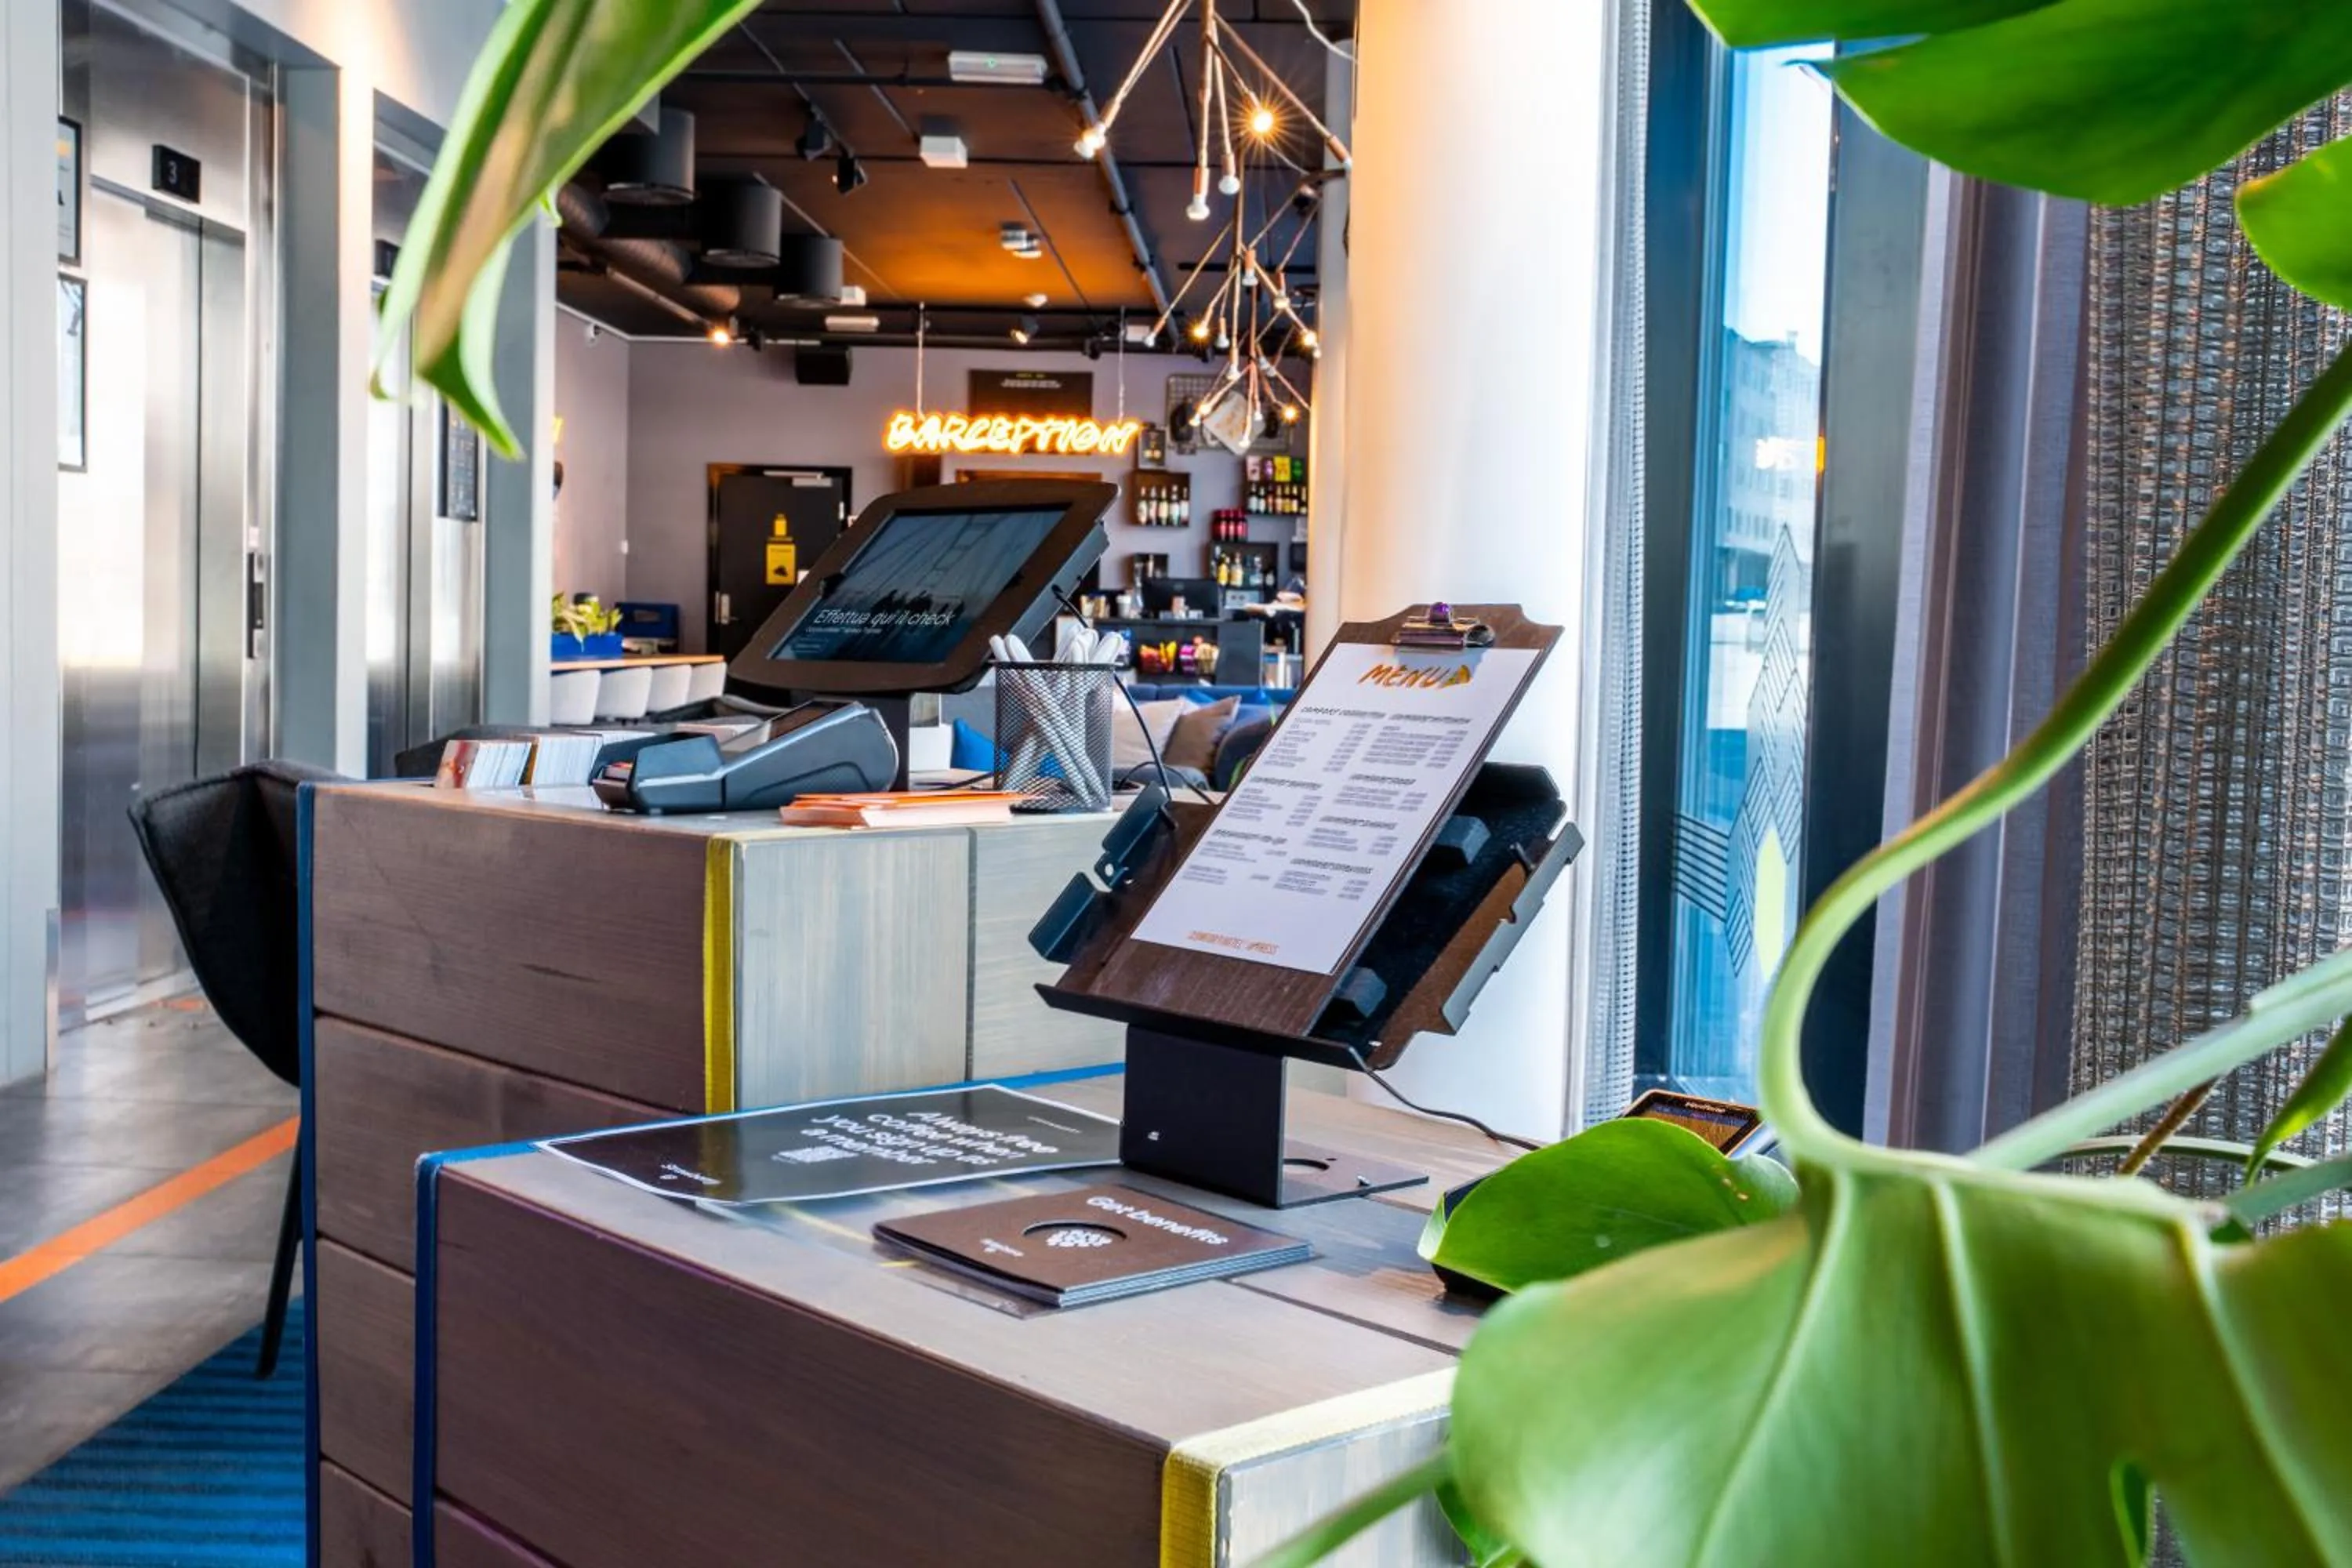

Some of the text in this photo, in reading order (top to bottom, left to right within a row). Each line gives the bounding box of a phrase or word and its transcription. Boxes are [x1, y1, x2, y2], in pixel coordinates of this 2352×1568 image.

[169, 160, 178, 185] 3
[886, 414, 1141, 453] BARCEPTION
[814, 608, 868, 625] Effettua
[870, 610, 899, 628] qui
[907, 610, 955, 626] check
[1357, 664, 1450, 688] MENU
[811, 1114, 876, 1134] you
[865, 1131, 927, 1149] sign
[919, 1145, 964, 1158] up
[995, 1134, 1058, 1153] free
[1086, 1196, 1229, 1245] Get benefits
